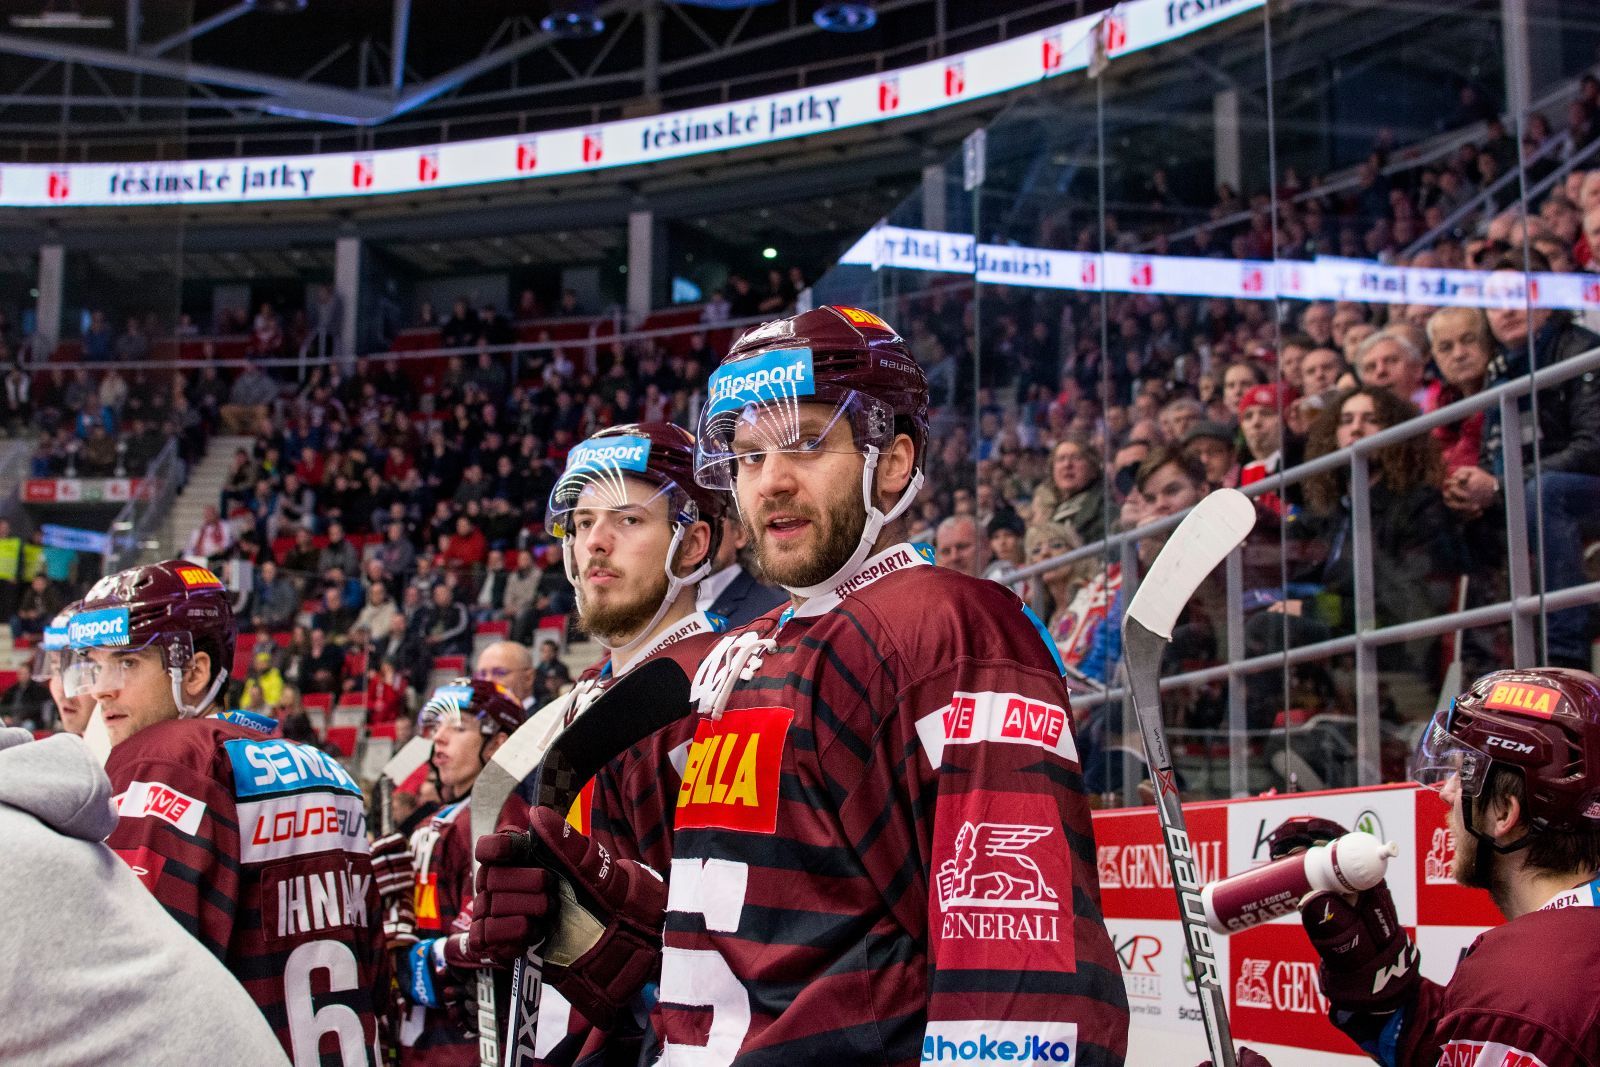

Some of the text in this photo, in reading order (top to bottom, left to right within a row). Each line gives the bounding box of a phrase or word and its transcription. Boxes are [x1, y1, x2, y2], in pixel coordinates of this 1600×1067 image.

[769, 95, 840, 137] jatky
[241, 164, 315, 195] jatky
[717, 361, 806, 399] Tipsport
[574, 446, 643, 467] Tipsport
[836, 550, 913, 600] #HCSPARTA
[71, 617, 124, 643] Tipsport
[1490, 685, 1551, 713] BILLA
[1004, 706, 1063, 739] AVE
[1486, 735, 1535, 754] CCM
[1273, 961, 1331, 1014] GEN
[937, 1033, 1070, 1062] hokejka
